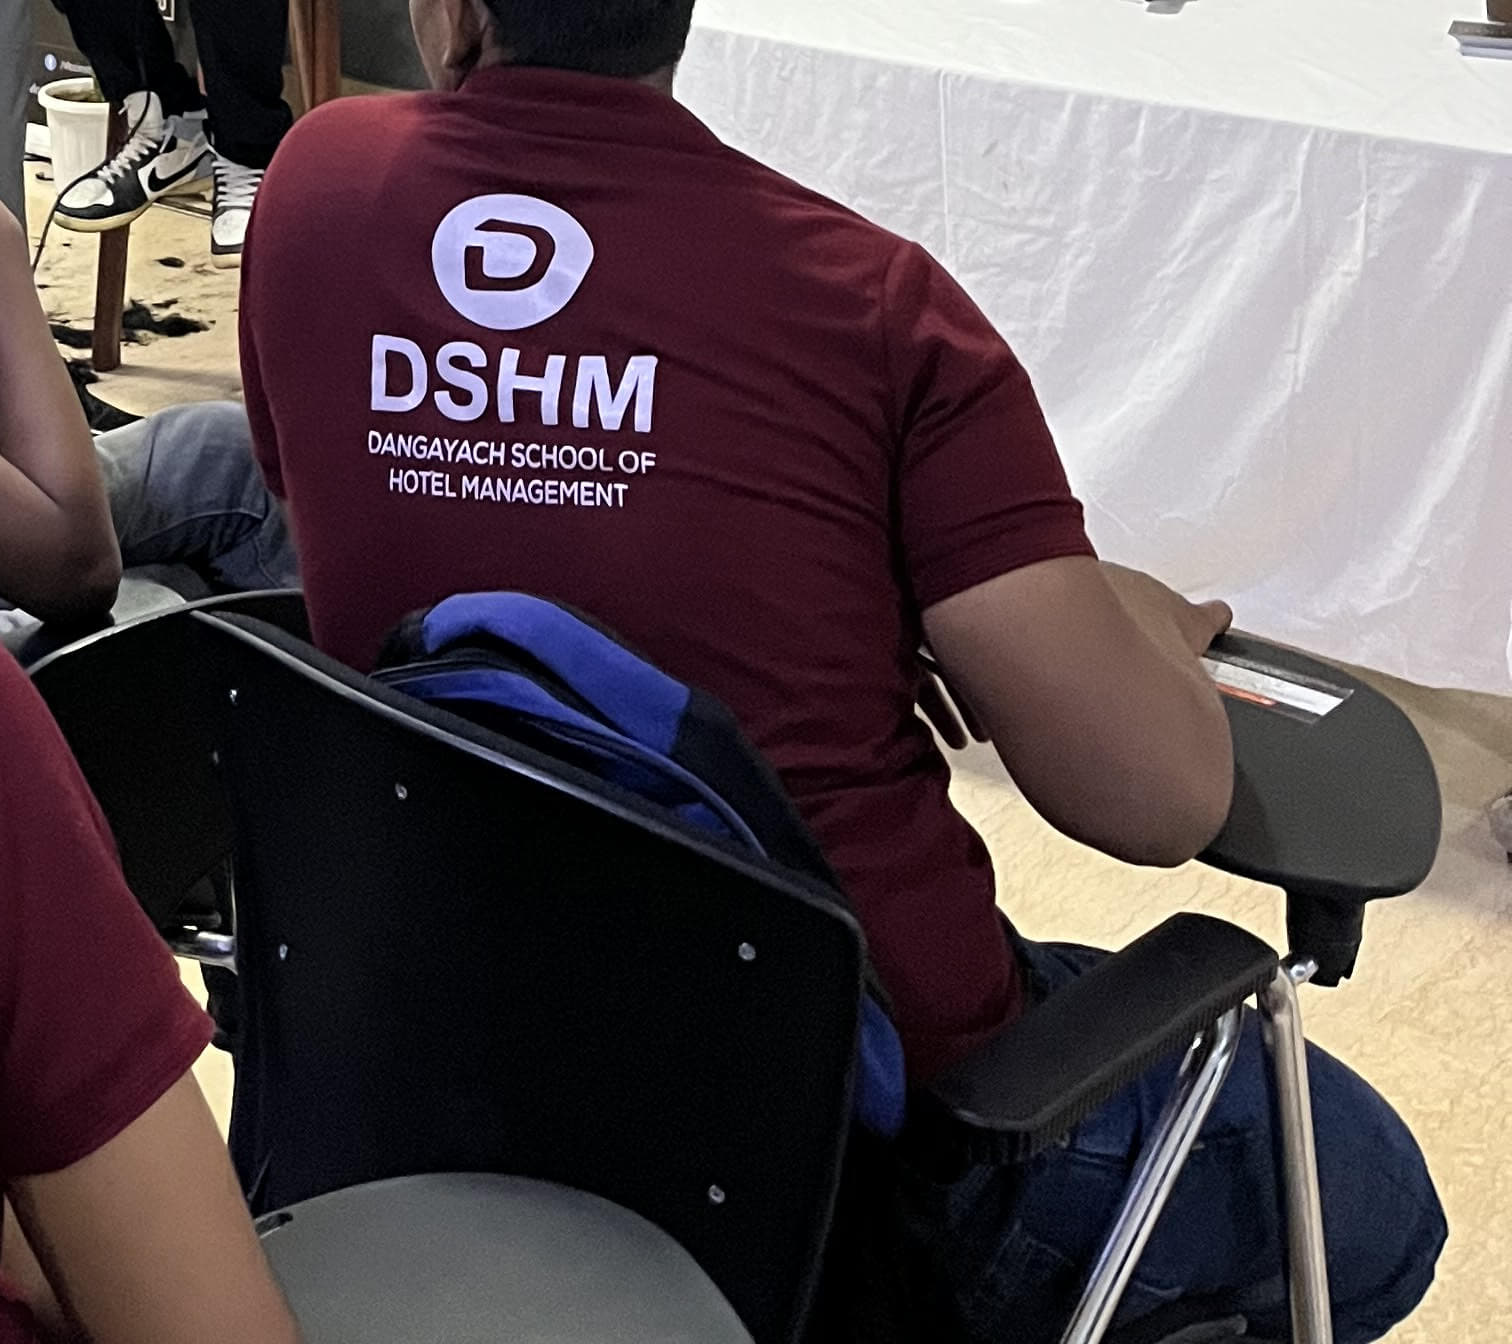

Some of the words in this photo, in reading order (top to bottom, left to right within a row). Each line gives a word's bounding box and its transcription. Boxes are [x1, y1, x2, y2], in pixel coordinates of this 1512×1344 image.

[370, 333, 658, 433] DSHM
[368, 429, 506, 466] DANGAYACH
[511, 443, 613, 472] SCHOOL
[618, 450, 657, 474] OF
[389, 468, 457, 499] HOTEL
[461, 475, 629, 508] MANAGEMENT
